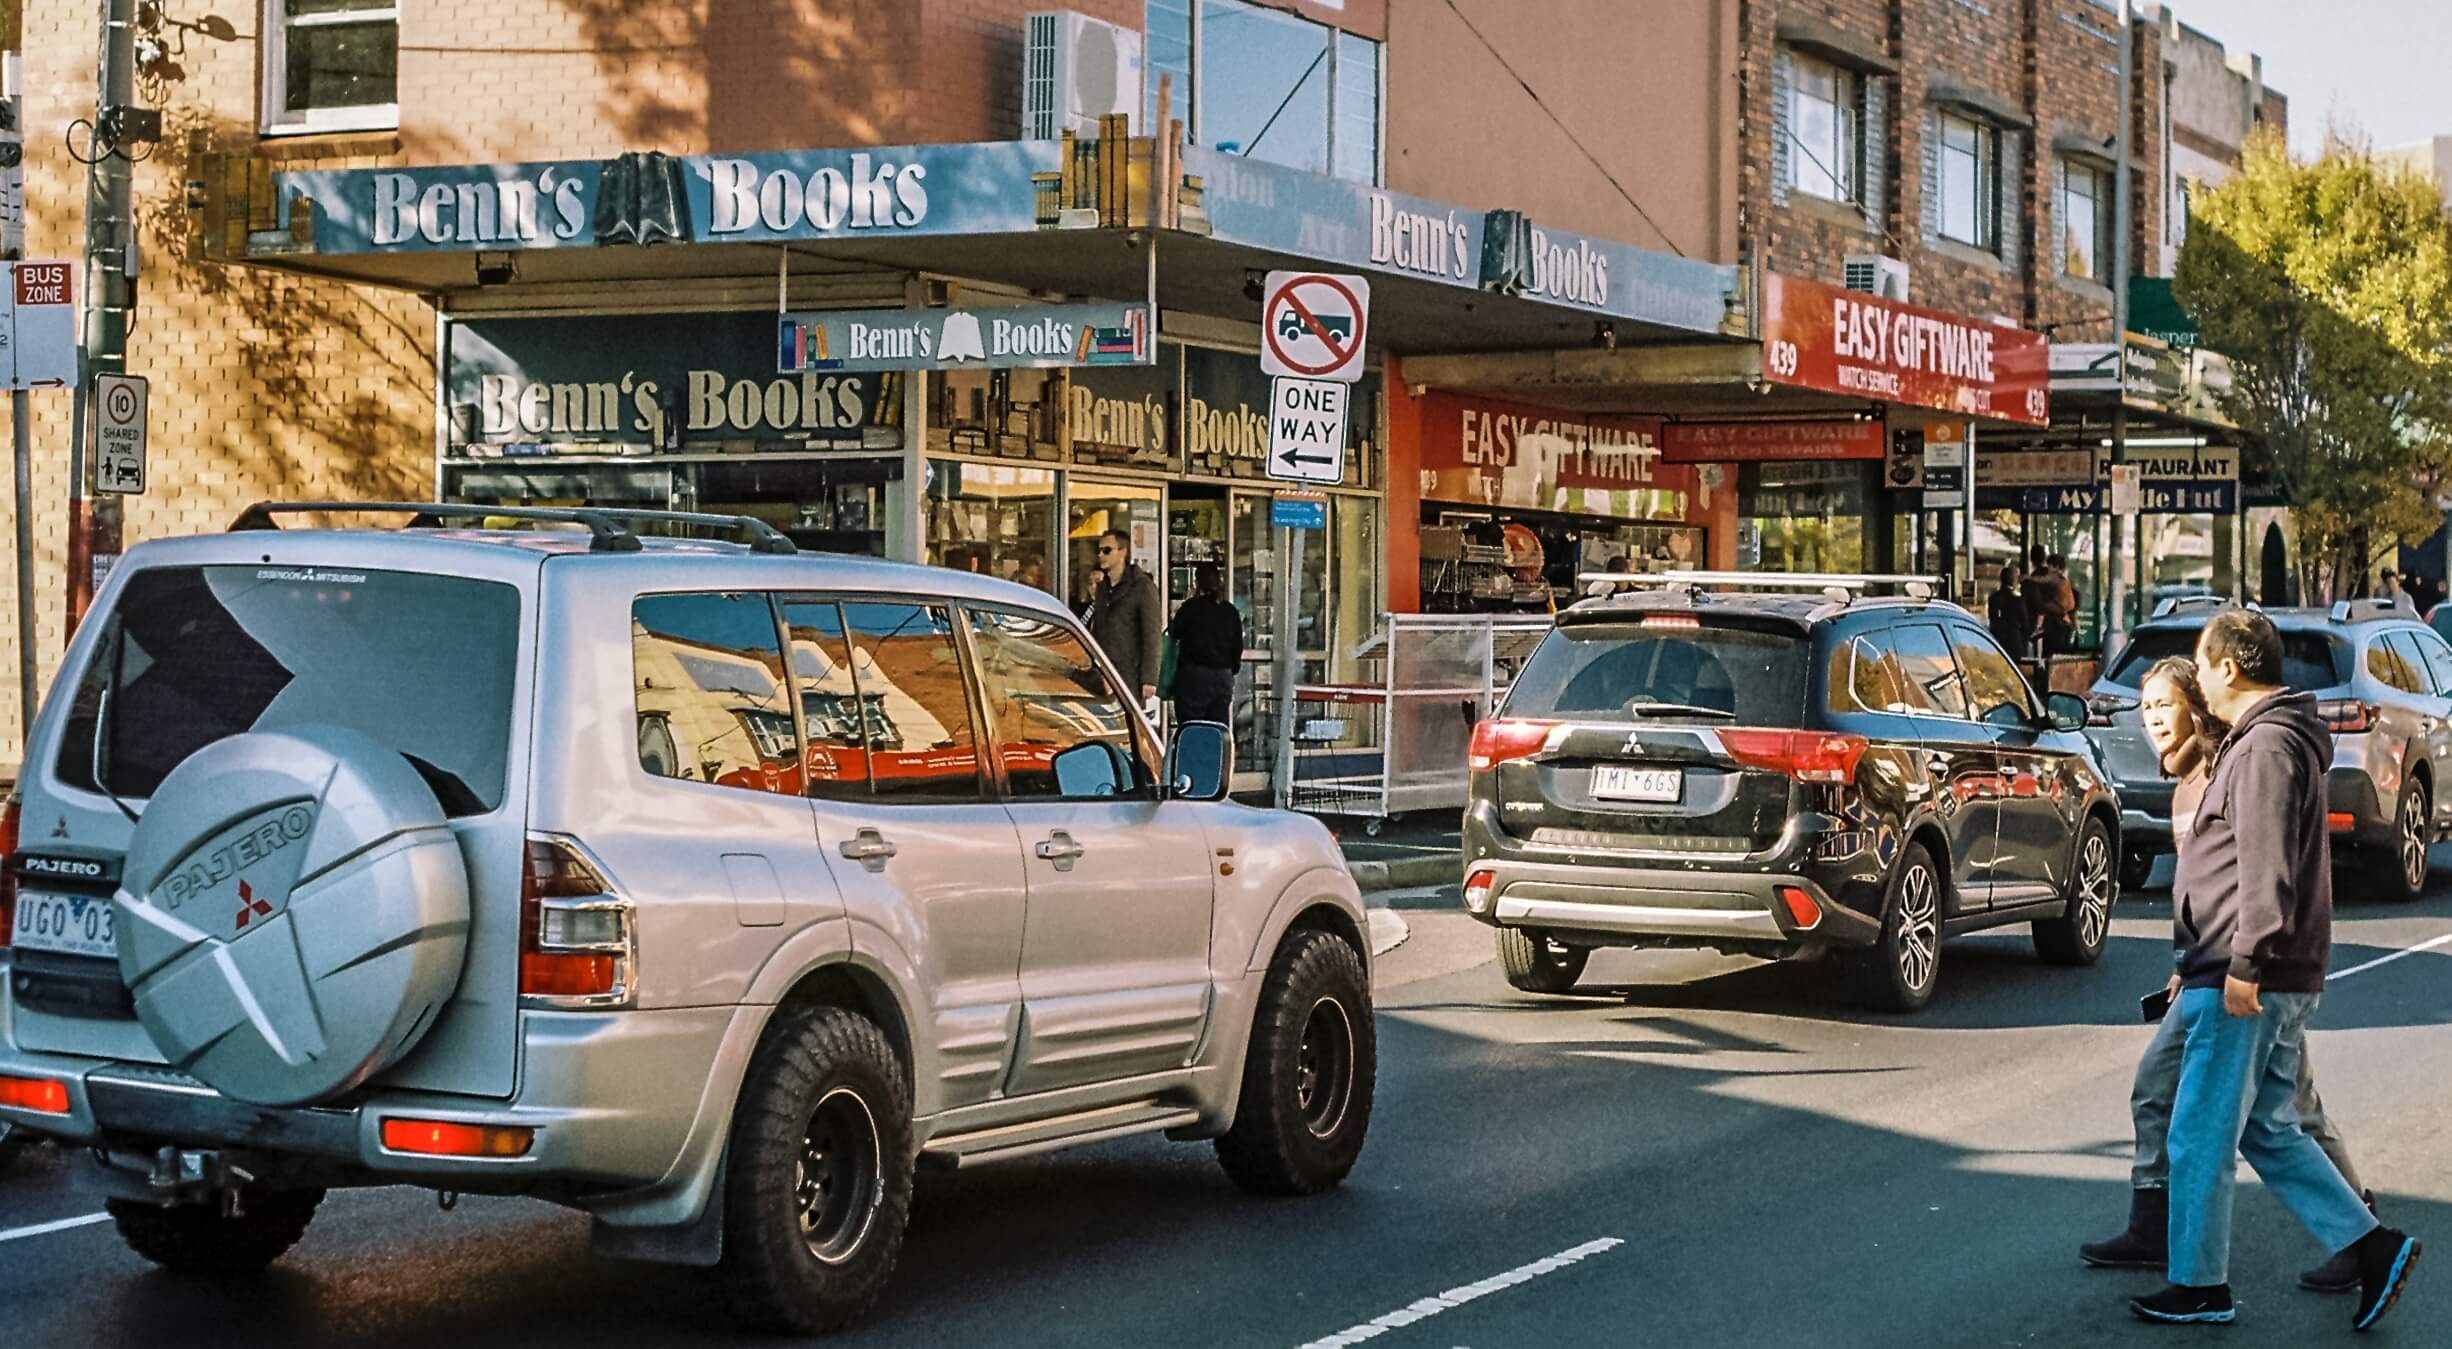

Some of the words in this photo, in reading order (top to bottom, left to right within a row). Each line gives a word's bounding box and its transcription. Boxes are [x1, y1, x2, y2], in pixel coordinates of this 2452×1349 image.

[373, 166, 585, 244] Benn's
[709, 153, 929, 233] Books
[1370, 193, 1467, 280] Benn's
[1529, 230, 1608, 306] Books
[23, 267, 64, 284] BUS
[26, 286, 63, 303] ZONE
[850, 320, 931, 359] Benn's
[992, 318, 1073, 355] Books
[1834, 298, 1890, 364] EASY
[1894, 313, 1994, 382] GIFTWARE
[1769, 340, 1797, 376] 439
[1868, 370, 1898, 395] SERVICE
[115, 395, 129, 413] 10
[481, 371, 658, 434] Benn's
[687, 371, 864, 432] Books
[1285, 387, 1336, 413] ONE
[103, 427, 140, 441] SHARED
[1071, 385, 1164, 450] Benn's
[1190, 398, 1268, 460] Books
[1280, 418, 1336, 444] WAY
[1747, 424, 1870, 441] GIFTWARE
[109, 442, 132, 454] ZONE
[1462, 409, 1528, 467] EASY
[1535, 420, 1653, 482] GIFTWARE
[2100, 458, 2230, 476] RTAURANT
[2058, 489, 2097, 510] My
[1643, 774, 1676, 792] 6GS
[25, 857, 101, 875] PAJERO
[163, 806, 311, 910] PAJERO
[85, 905, 113, 942] 03
